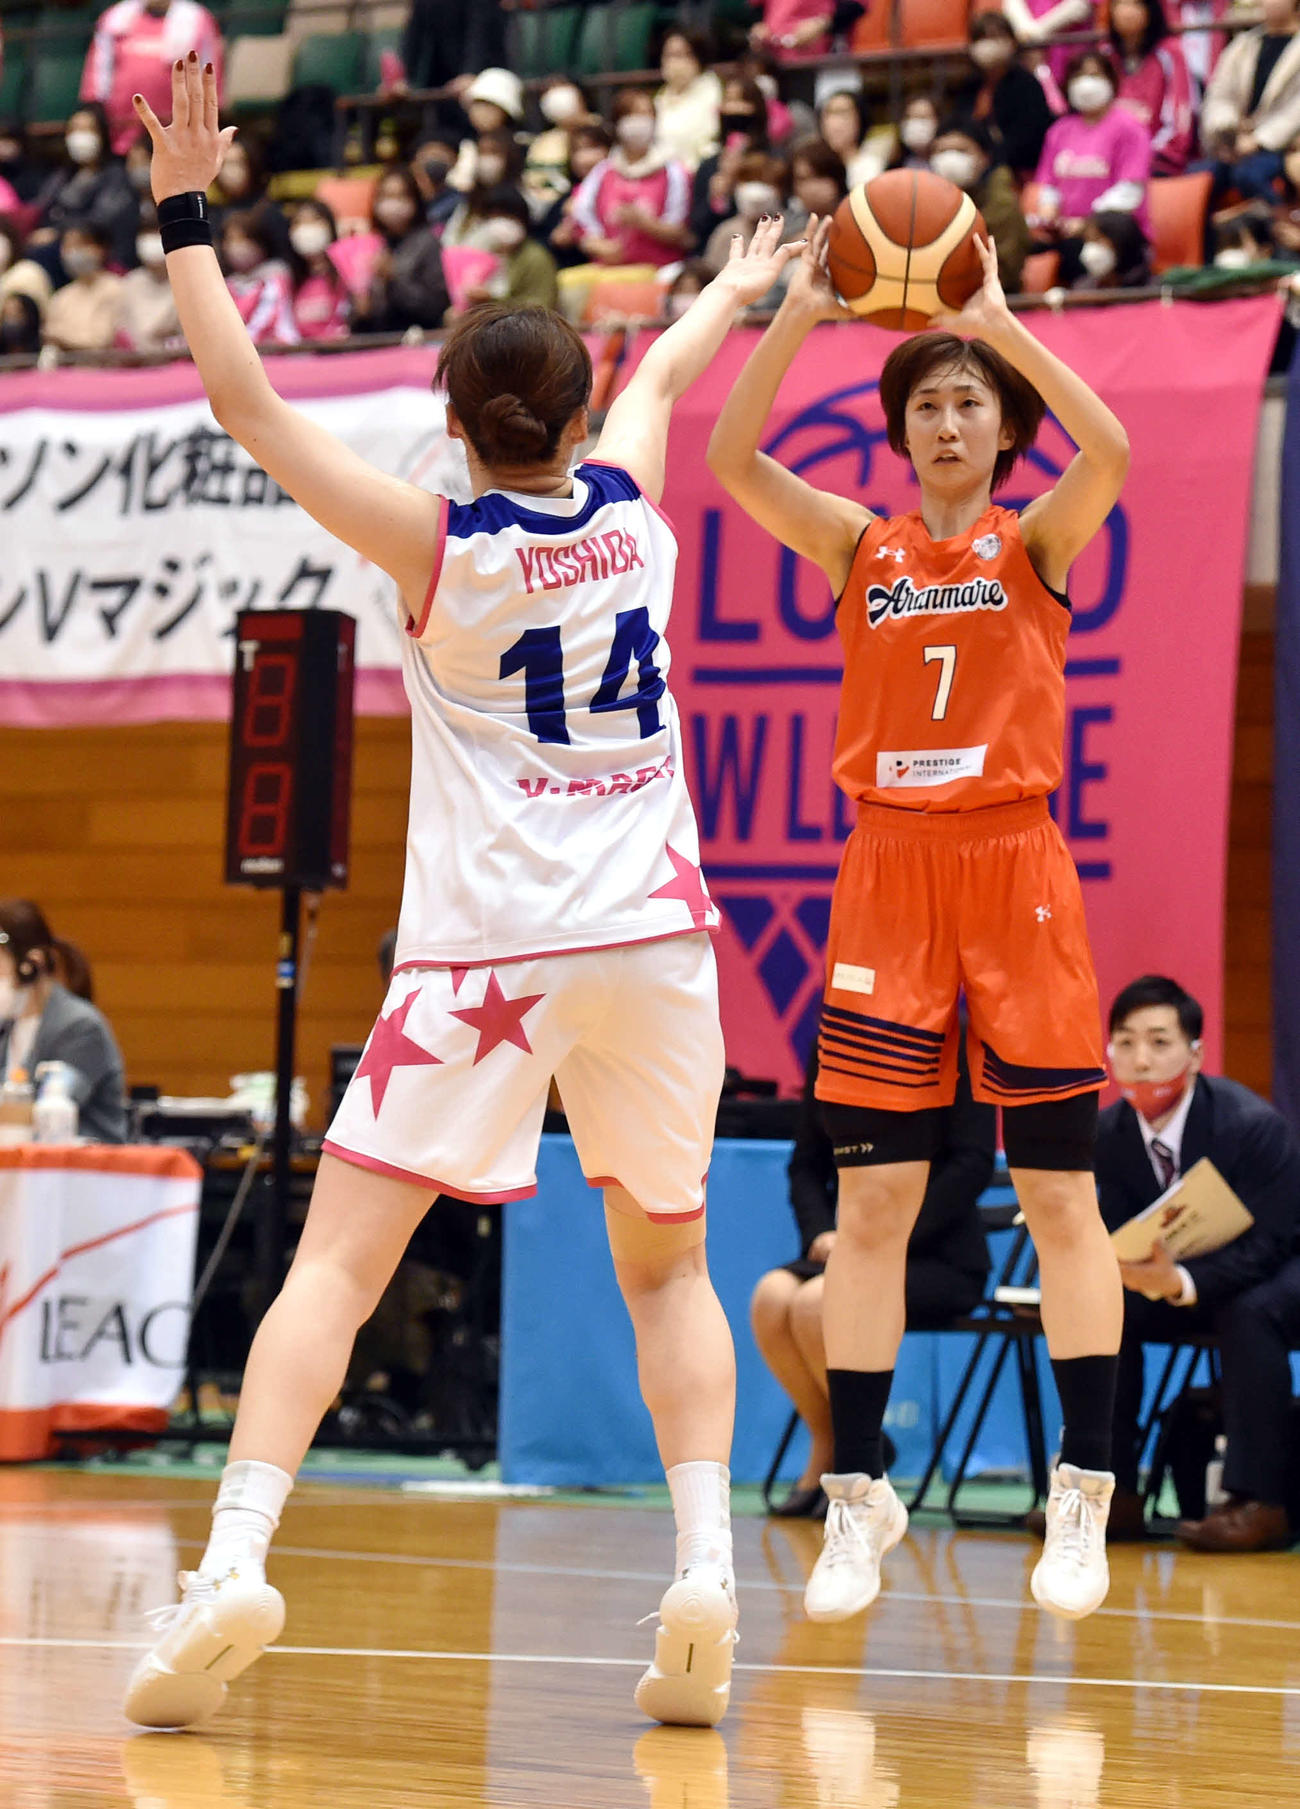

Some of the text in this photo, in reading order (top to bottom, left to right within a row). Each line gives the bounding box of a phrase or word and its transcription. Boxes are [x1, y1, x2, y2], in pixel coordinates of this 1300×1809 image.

[514, 529, 644, 594] YOSHIDA
[867, 576, 1006, 628] Aranmare
[499, 606, 667, 746] 14
[922, 645, 958, 721] 7
[912, 758, 962, 768] PRESTIGE
